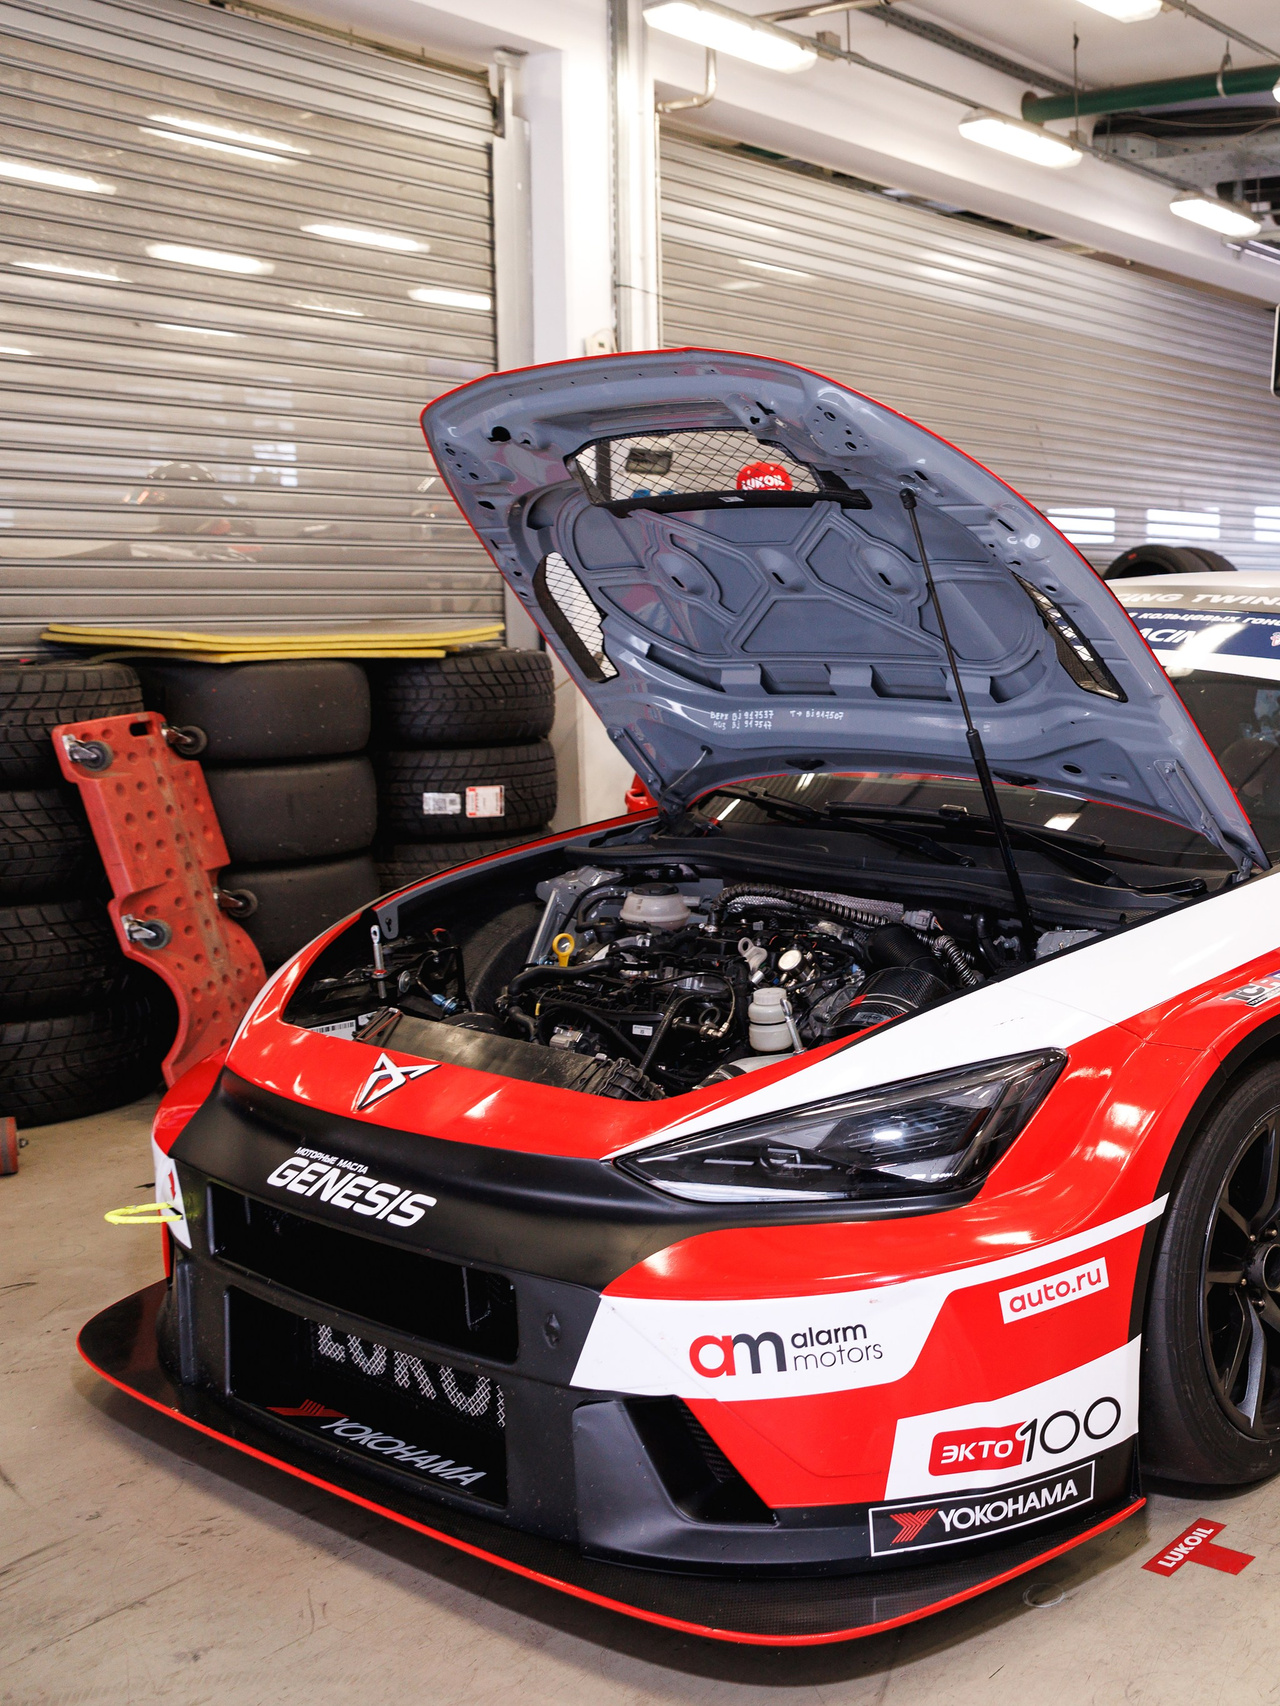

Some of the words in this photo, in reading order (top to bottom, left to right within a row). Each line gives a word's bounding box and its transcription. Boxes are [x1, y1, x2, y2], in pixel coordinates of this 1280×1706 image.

[1139, 627, 1200, 644] ACIN
[294, 1146, 338, 1165] МОТОРНЫЕ
[336, 1159, 369, 1174] МАСЛА
[266, 1156, 438, 1228] GENESIS
[1009, 1266, 1102, 1314] auto.ru
[689, 1330, 787, 1378] am
[790, 1323, 868, 1348] alarm
[793, 1342, 884, 1372] motors
[317, 1323, 506, 1428] LUKO
[320, 1417, 488, 1487] YOKOHAMA
[938, 1479, 1079, 1533] YOKOHAMA
[1157, 1527, 1214, 1568] LUKOIL
